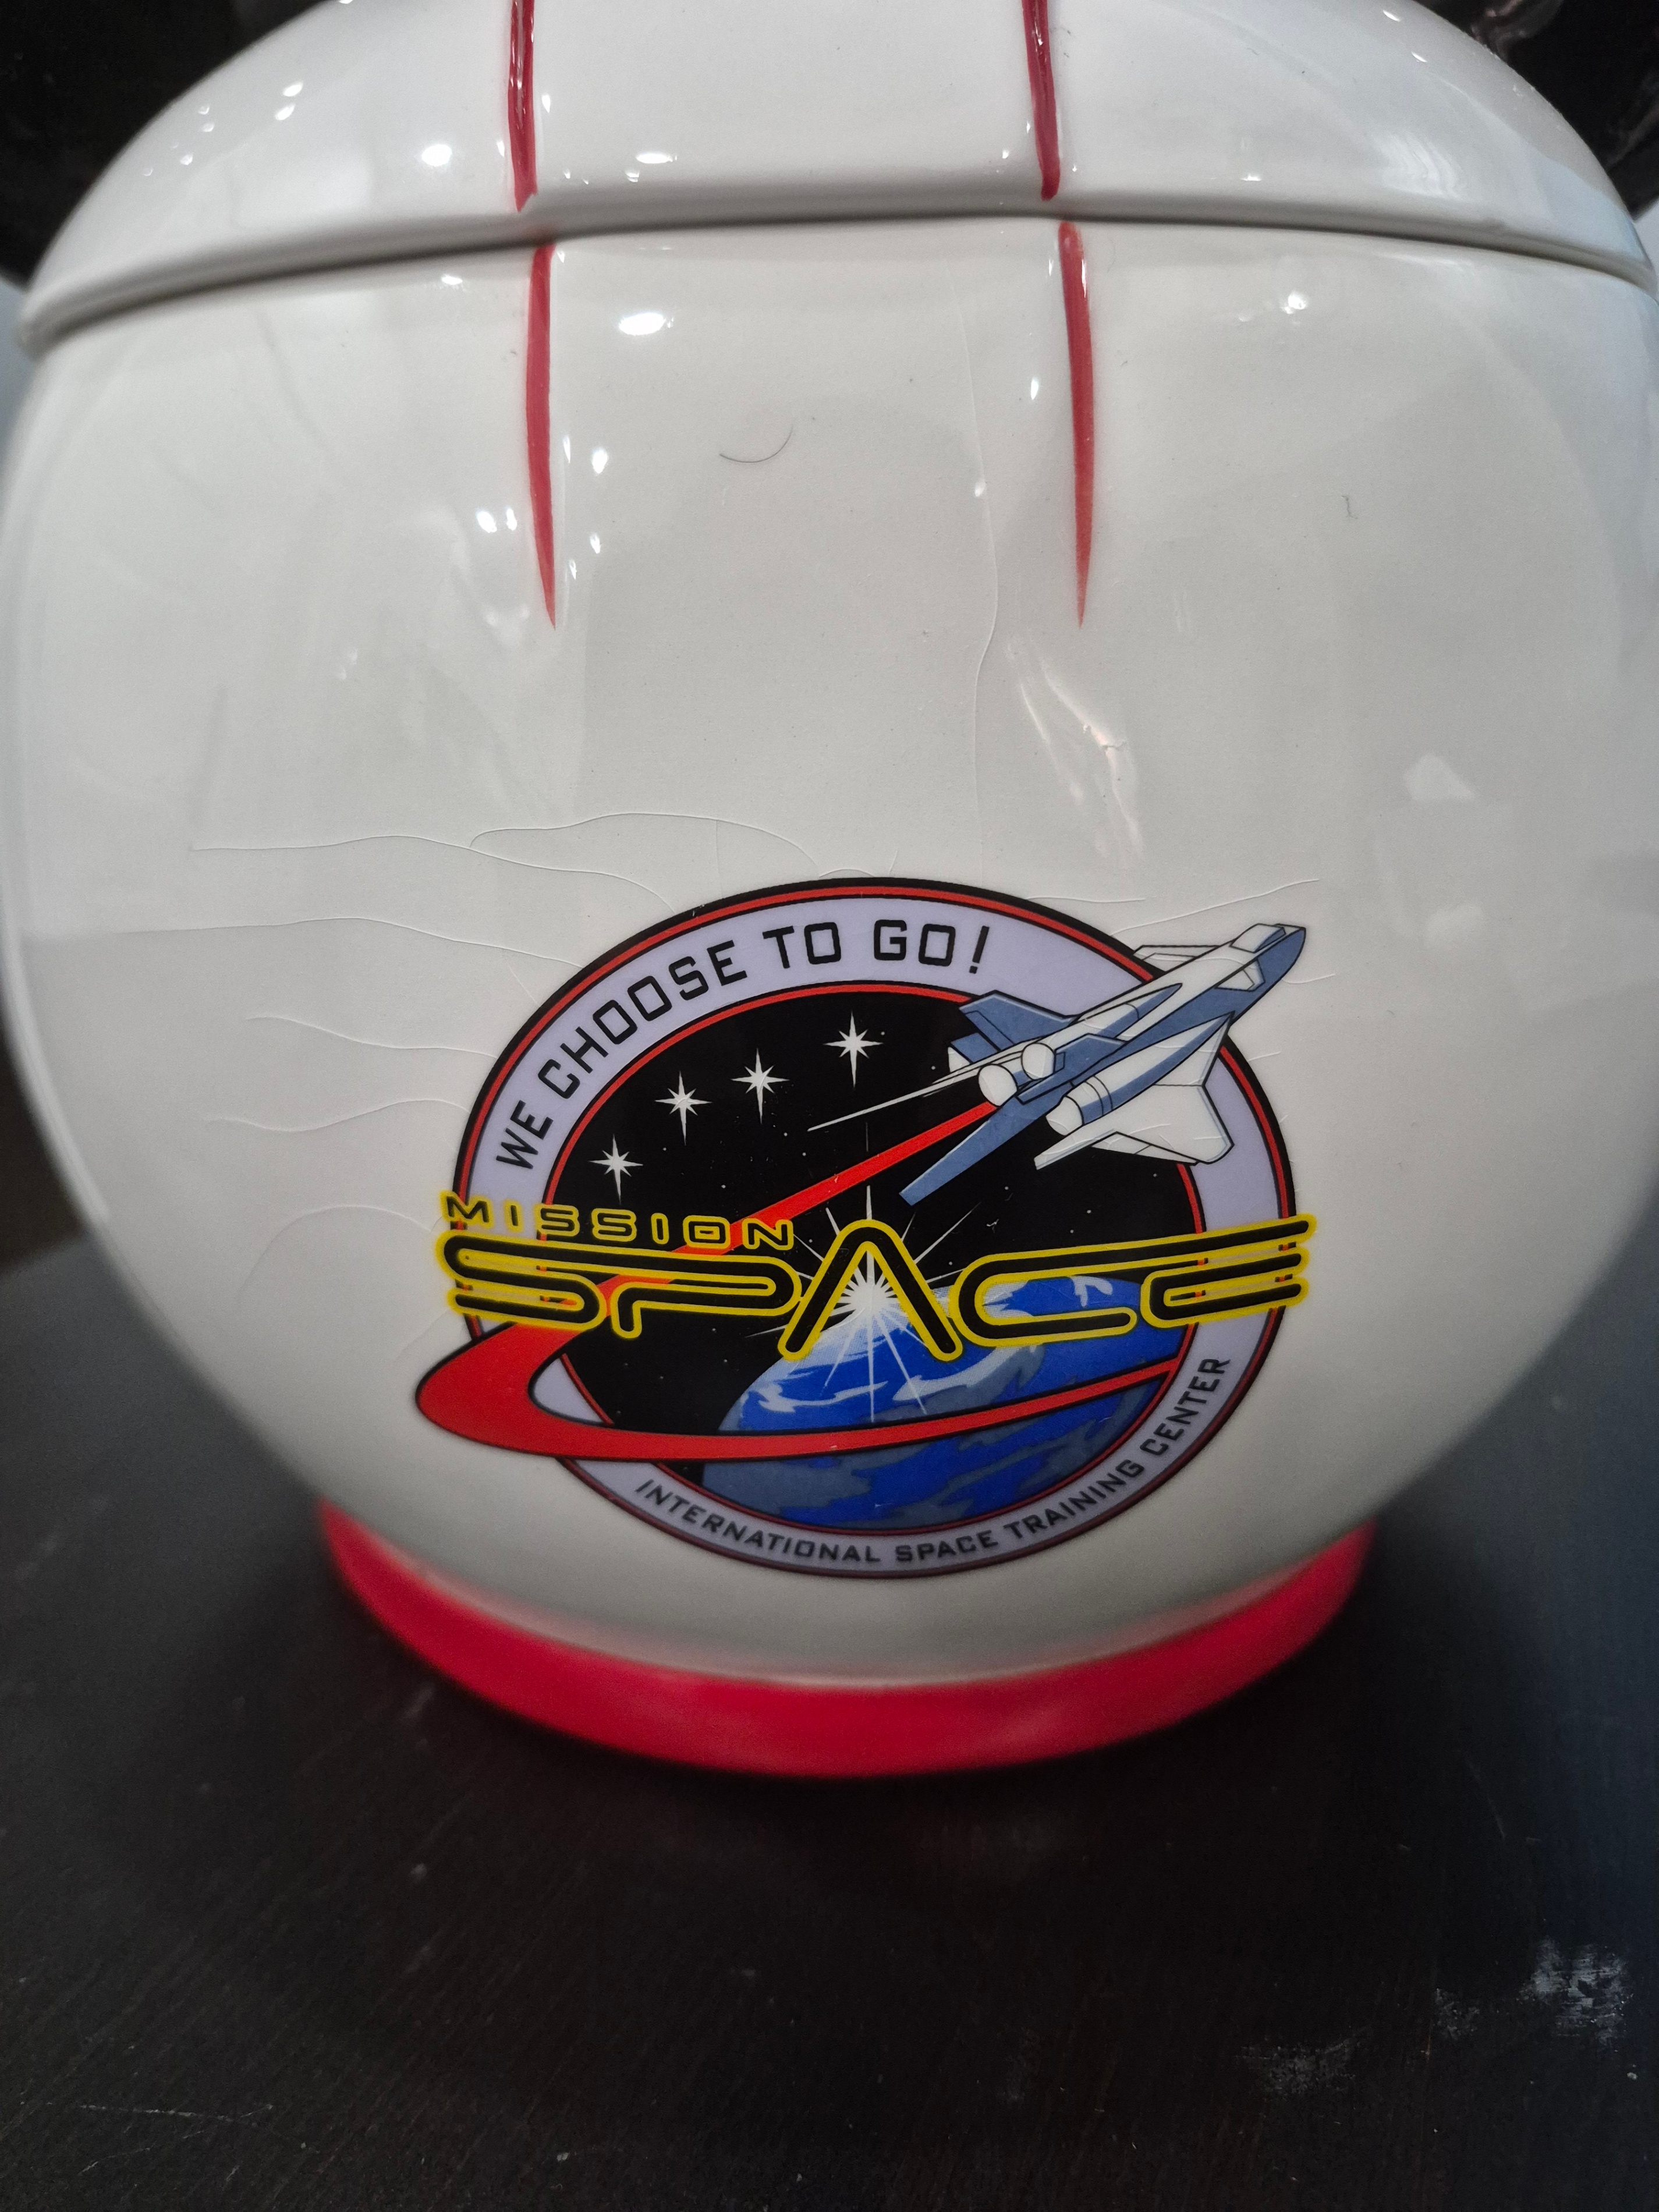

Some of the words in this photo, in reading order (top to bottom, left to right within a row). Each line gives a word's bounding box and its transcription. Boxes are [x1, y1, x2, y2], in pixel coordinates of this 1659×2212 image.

[496, 1100, 553, 1169] WE
[538, 940, 747, 1099] CHOOSE
[763, 922, 841, 969] TO
[873, 920, 990, 974] GO!
[437, 1213, 1316, 1361] SPACE
[441, 1190, 793, 1250] MISSION
[636, 1479, 881, 1562] INTERNATIONAL
[895, 1530, 998, 1562] SPACE
[1004, 1459, 1144, 1539] TRAINING
[1139, 1358, 1231, 1456] CENTER
